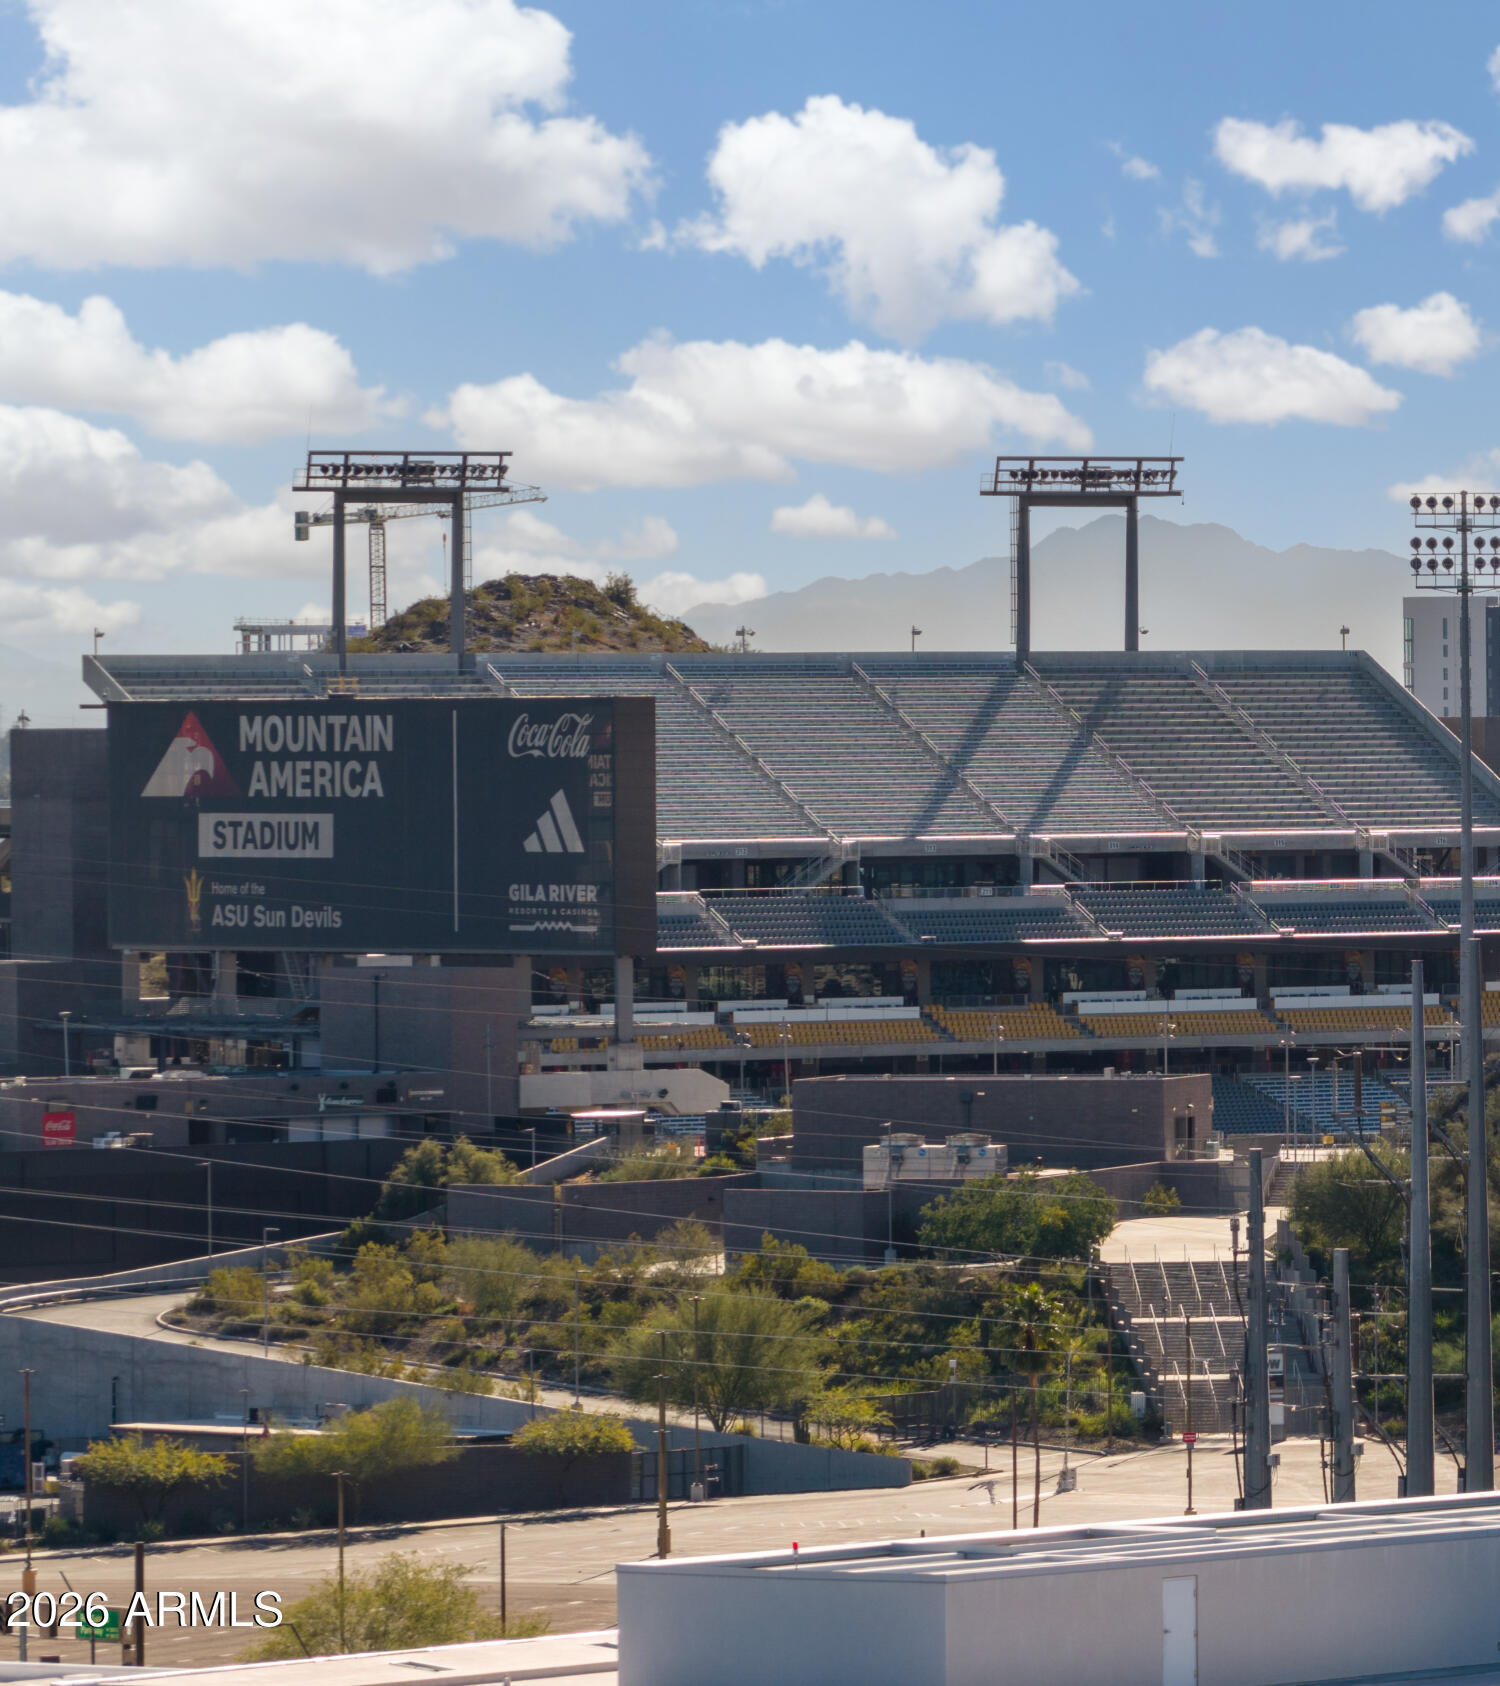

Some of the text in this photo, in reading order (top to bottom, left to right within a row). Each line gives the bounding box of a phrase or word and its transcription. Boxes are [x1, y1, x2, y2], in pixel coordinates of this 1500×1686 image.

[239, 714, 393, 752] MOUNTAIN
[508, 713, 594, 758] Coca-Cola
[248, 760, 384, 798] AMERICA
[212, 820, 320, 851] STADIUM
[211, 882, 266, 895] Home of the
[508, 884, 598, 903] GILA RIVER
[212, 904, 343, 929] ASU Sun Devils
